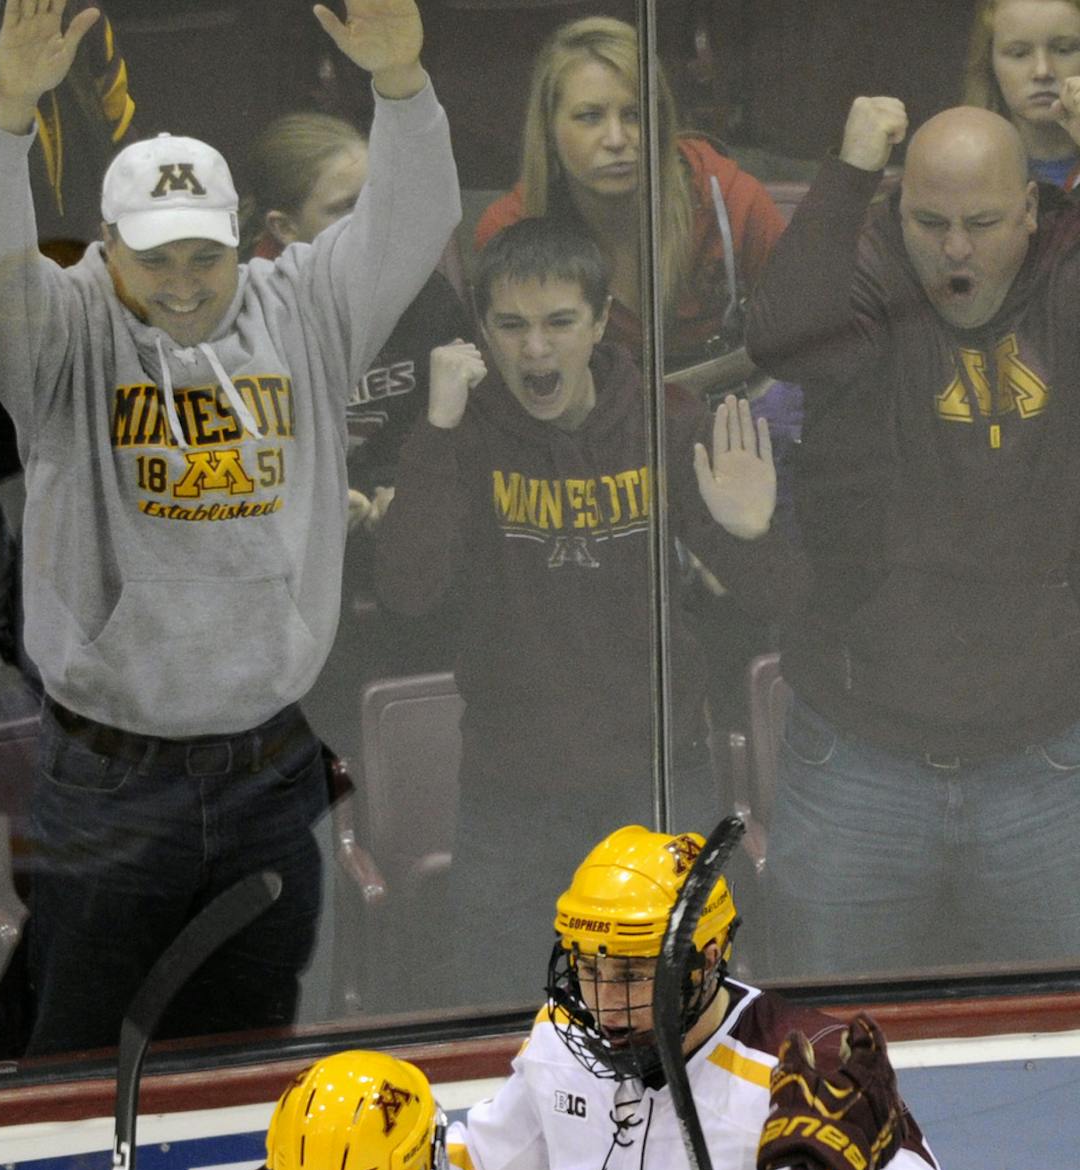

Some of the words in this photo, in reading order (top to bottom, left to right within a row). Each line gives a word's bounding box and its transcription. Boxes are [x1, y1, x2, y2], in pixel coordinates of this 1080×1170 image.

[150, 162, 208, 199] M
[136, 455, 168, 493] 18
[173, 449, 254, 497] M
[257, 448, 286, 488] 51
[143, 496, 279, 521] Established
[568, 917, 612, 934] GOPHERS
